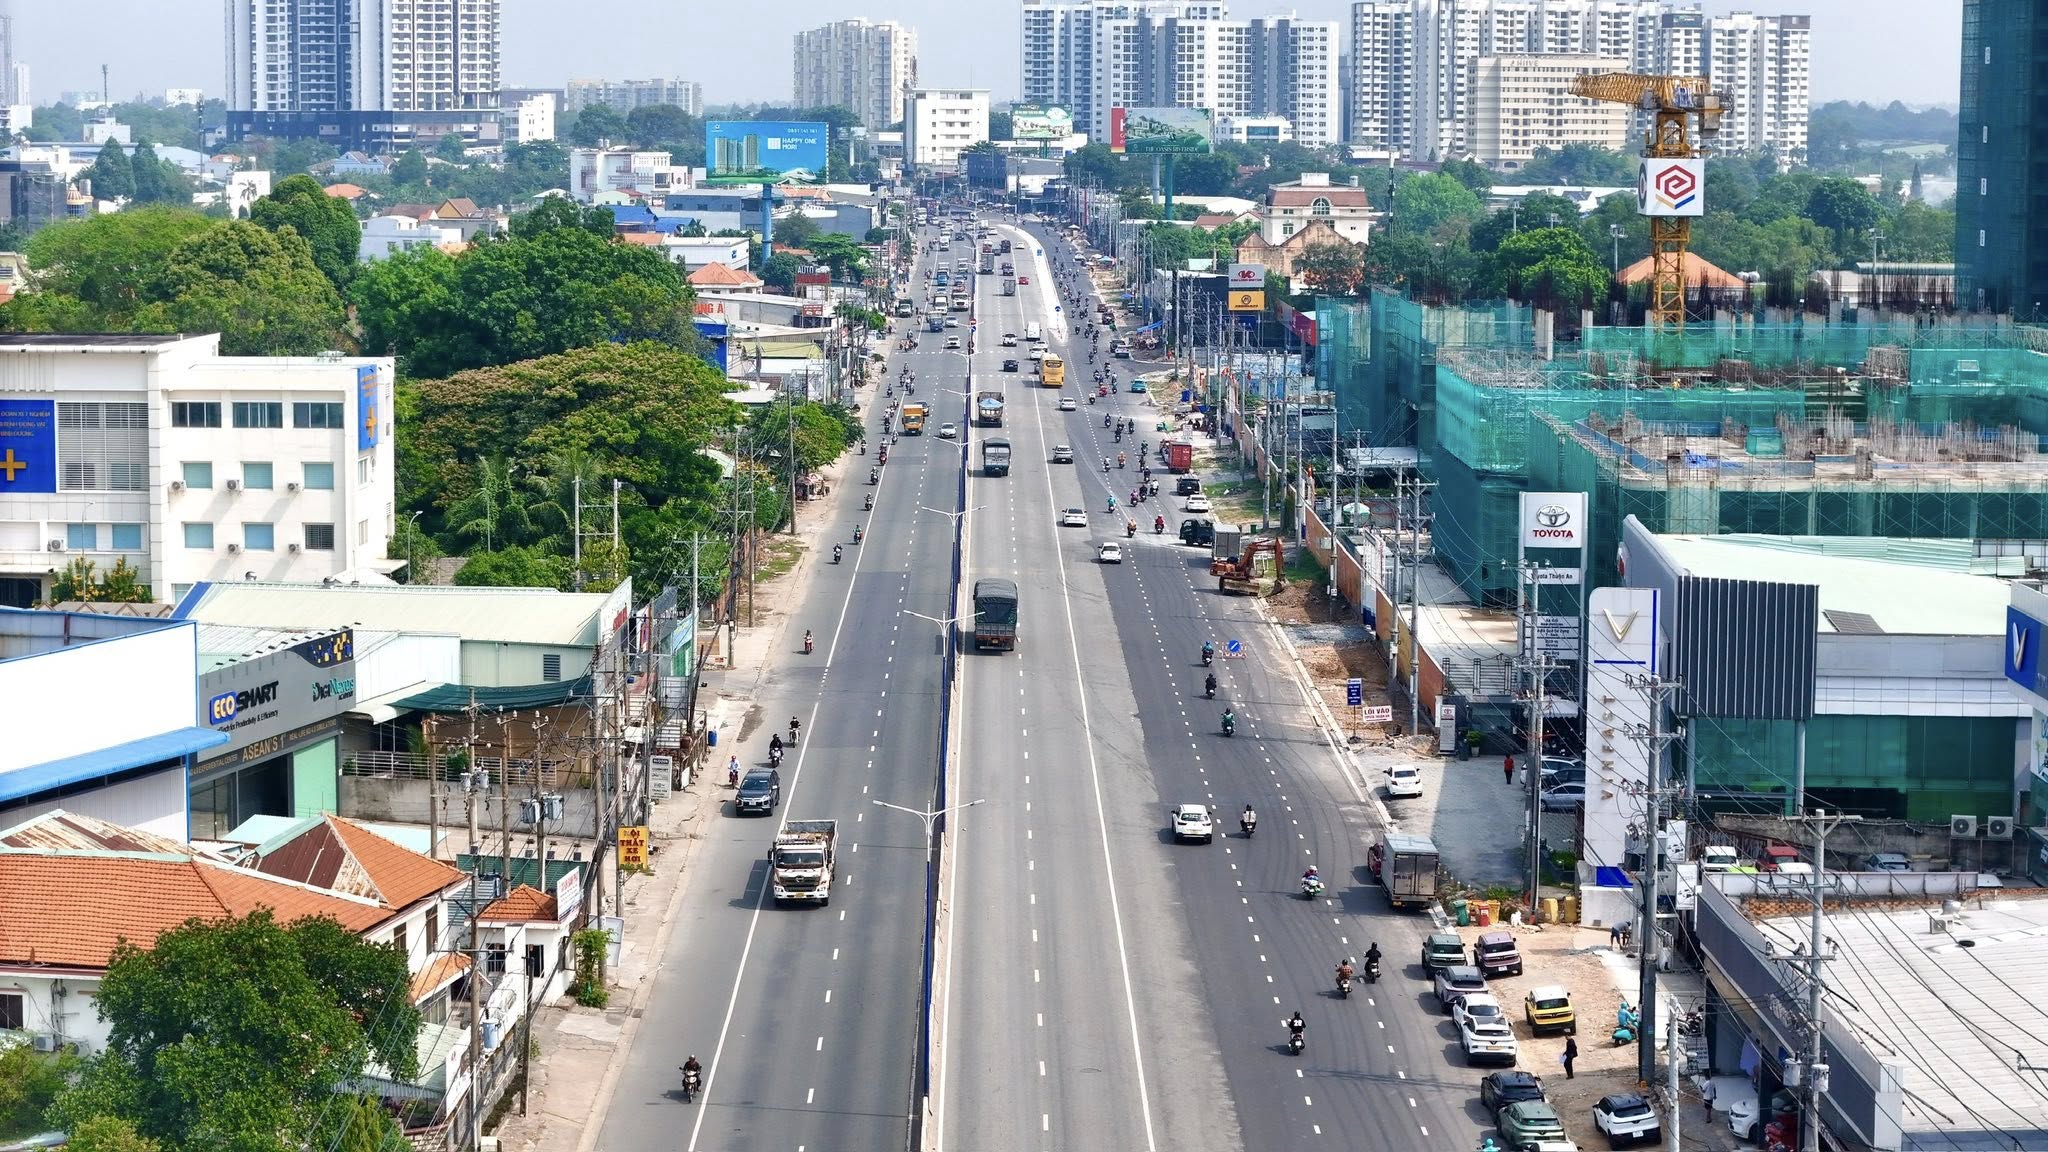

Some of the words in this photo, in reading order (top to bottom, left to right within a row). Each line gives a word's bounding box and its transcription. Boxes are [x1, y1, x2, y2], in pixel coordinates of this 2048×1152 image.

[798, 265, 814, 274] AUTO
[1533, 529, 1574, 538] TOYOTA
[242, 736, 279, 763] ASEAN'S
